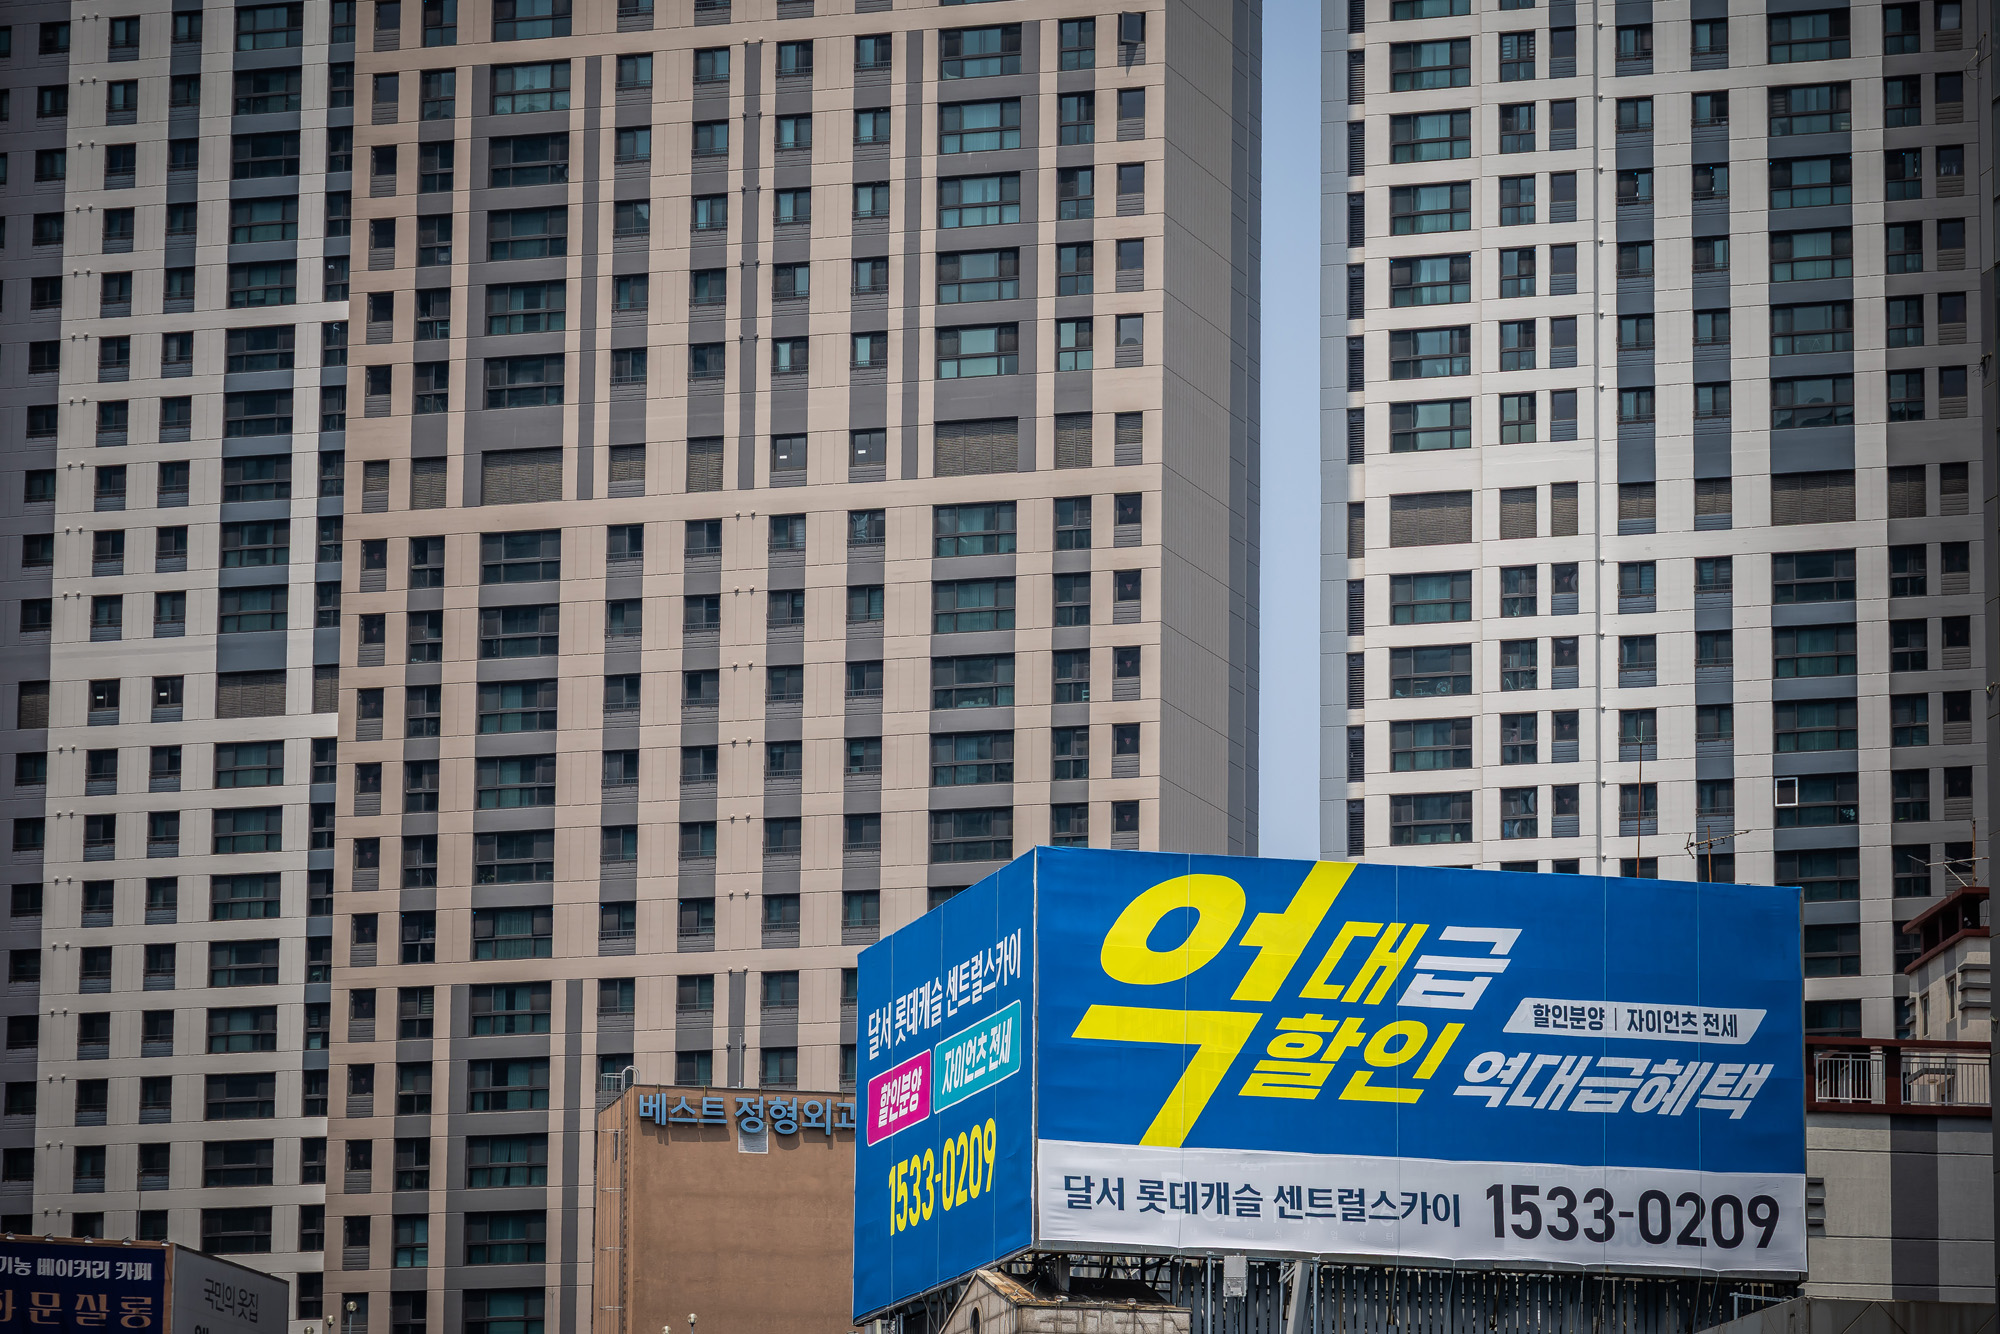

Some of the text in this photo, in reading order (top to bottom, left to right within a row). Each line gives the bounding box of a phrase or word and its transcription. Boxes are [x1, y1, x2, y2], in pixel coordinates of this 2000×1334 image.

[868, 927, 1022, 1061] 달서 롯데캐슬 센트럴스카이
[1532, 1003, 1738, 1038] 할인분양 자이언츠 전세
[941, 1016, 1013, 1095] 자이언츠 전세
[1238, 1013, 1465, 1104] 할인
[1453, 1051, 1775, 1120] 역대급혜택
[639, 1092, 728, 1126] 베스트
[878, 1065, 923, 1129] 할인분양
[888, 1117, 997, 1237] 1533-0209
[1063, 1174, 1461, 1228] 달서 롯데캐슬 센트럴스카이
[1486, 1183, 1780, 1250] 1533-0209
[36, 1257, 110, 1280] 베이커리
[115, 1261, 153, 1281] 카페
[203, 1277, 259, 1324] 국민의 옷집
